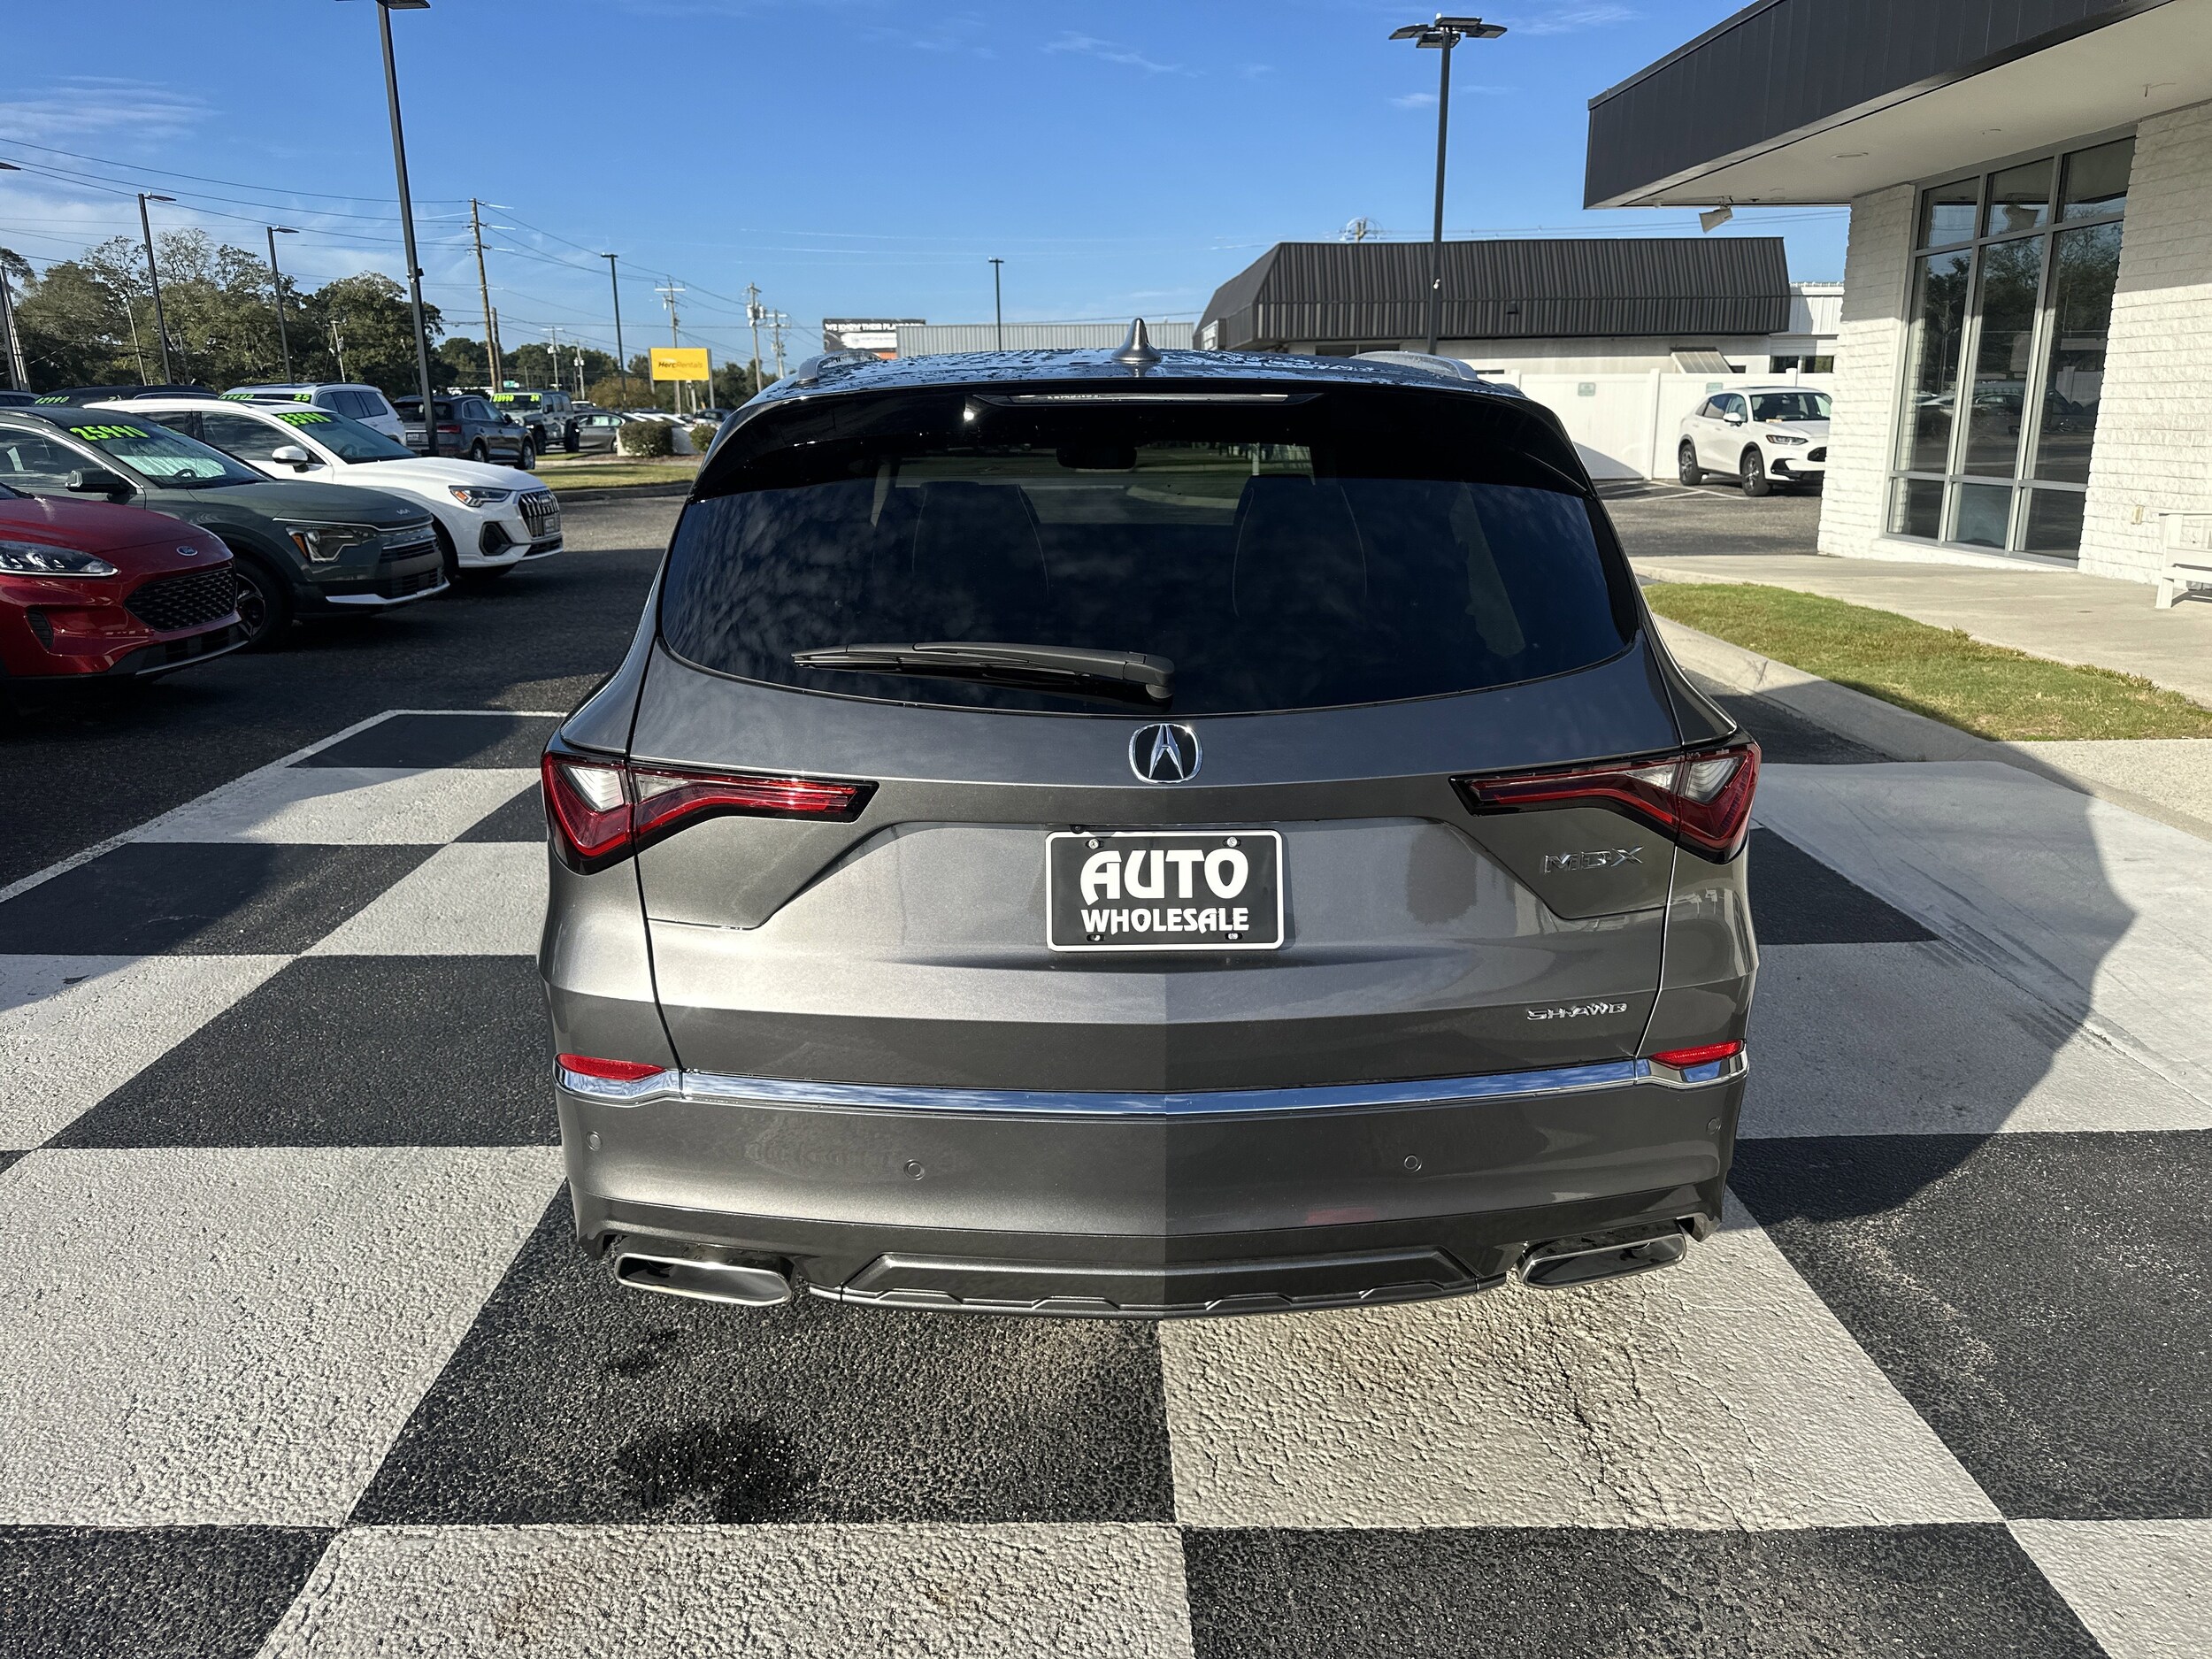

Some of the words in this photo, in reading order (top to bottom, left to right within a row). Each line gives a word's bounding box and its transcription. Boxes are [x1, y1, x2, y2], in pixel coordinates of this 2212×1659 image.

[70, 425, 150, 441] 25990
[1542, 846, 1645, 874] MDX
[1079, 848, 1249, 906] AUTO
[1080, 907, 1250, 935] WHOLESALE
